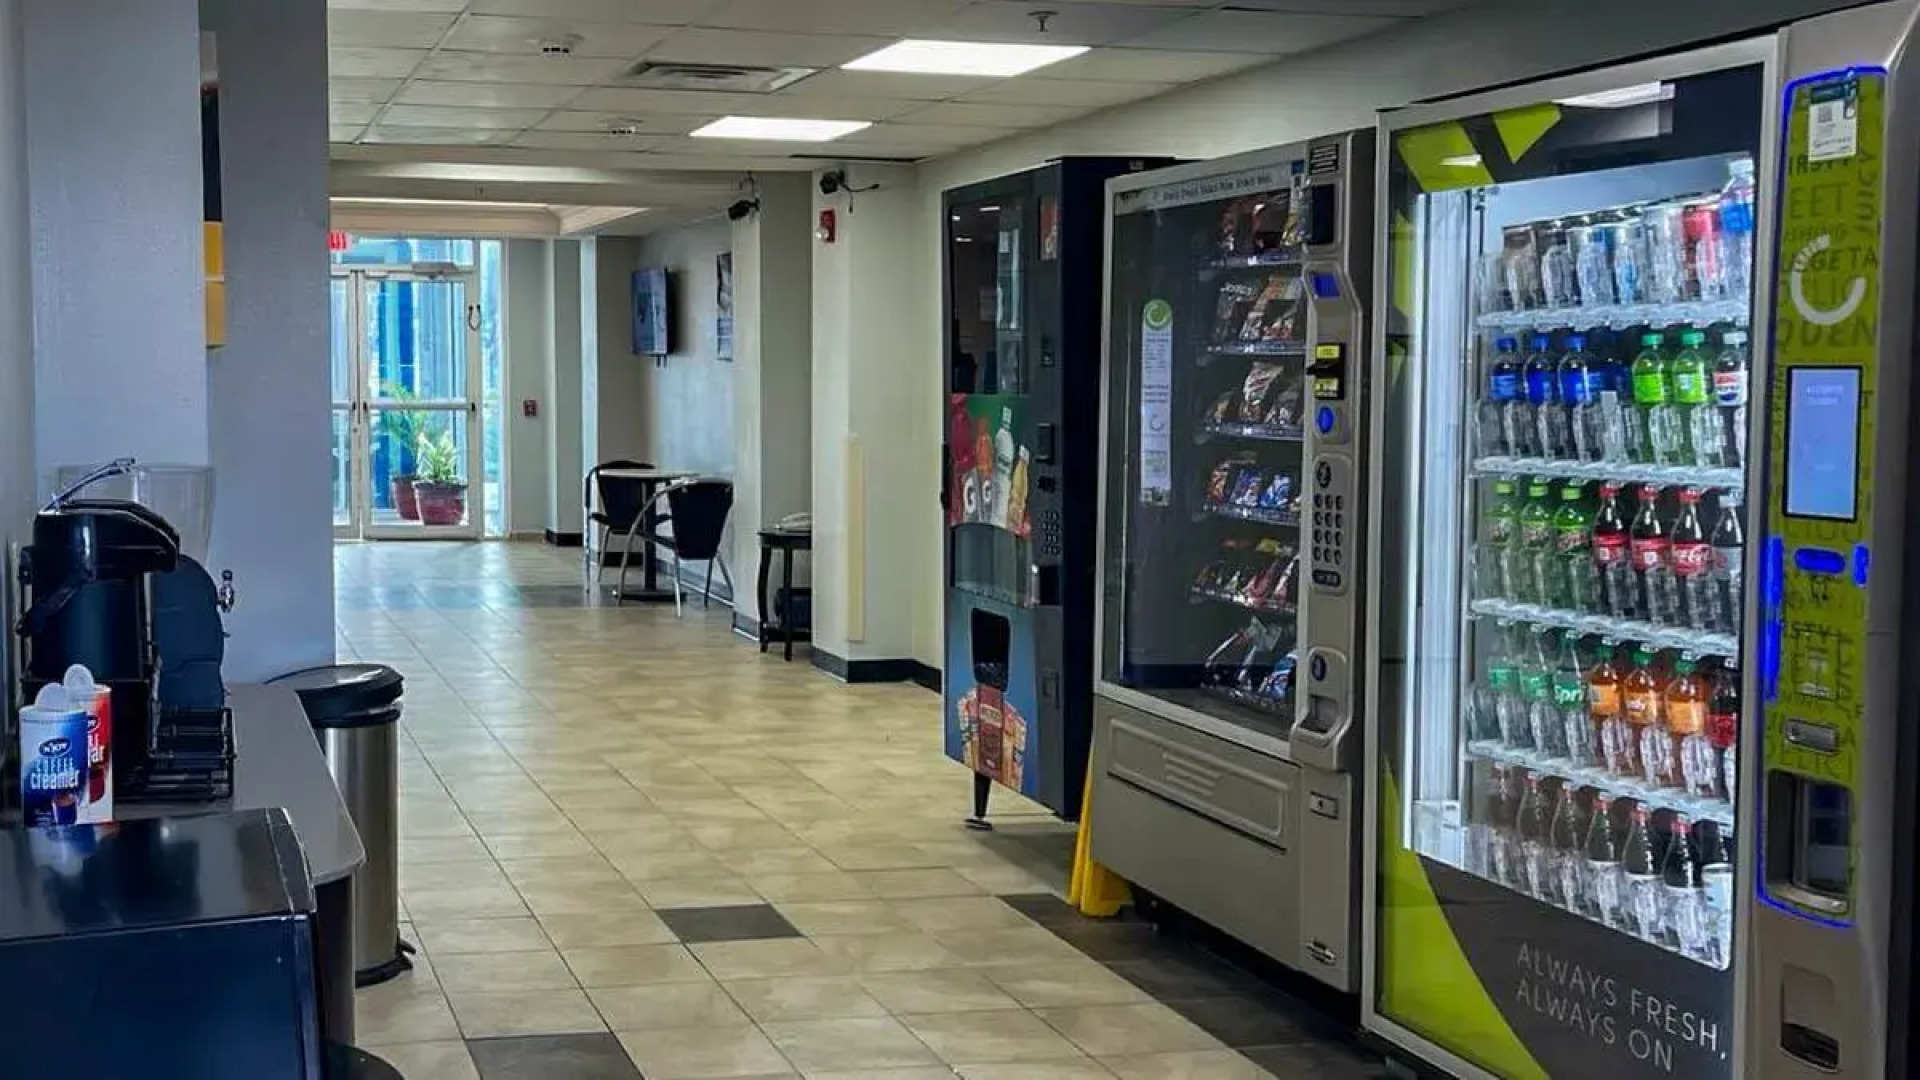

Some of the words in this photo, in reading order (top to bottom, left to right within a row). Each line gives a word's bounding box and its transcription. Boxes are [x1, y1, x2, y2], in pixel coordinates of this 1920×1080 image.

[30, 769, 80, 790] creamer
[1516, 978, 1616, 1044] ALWAYS
[1628, 1028, 1673, 1073] ON
[1517, 943, 1617, 1007] ALWAYS
[1631, 988, 1727, 1061] FRESH.
